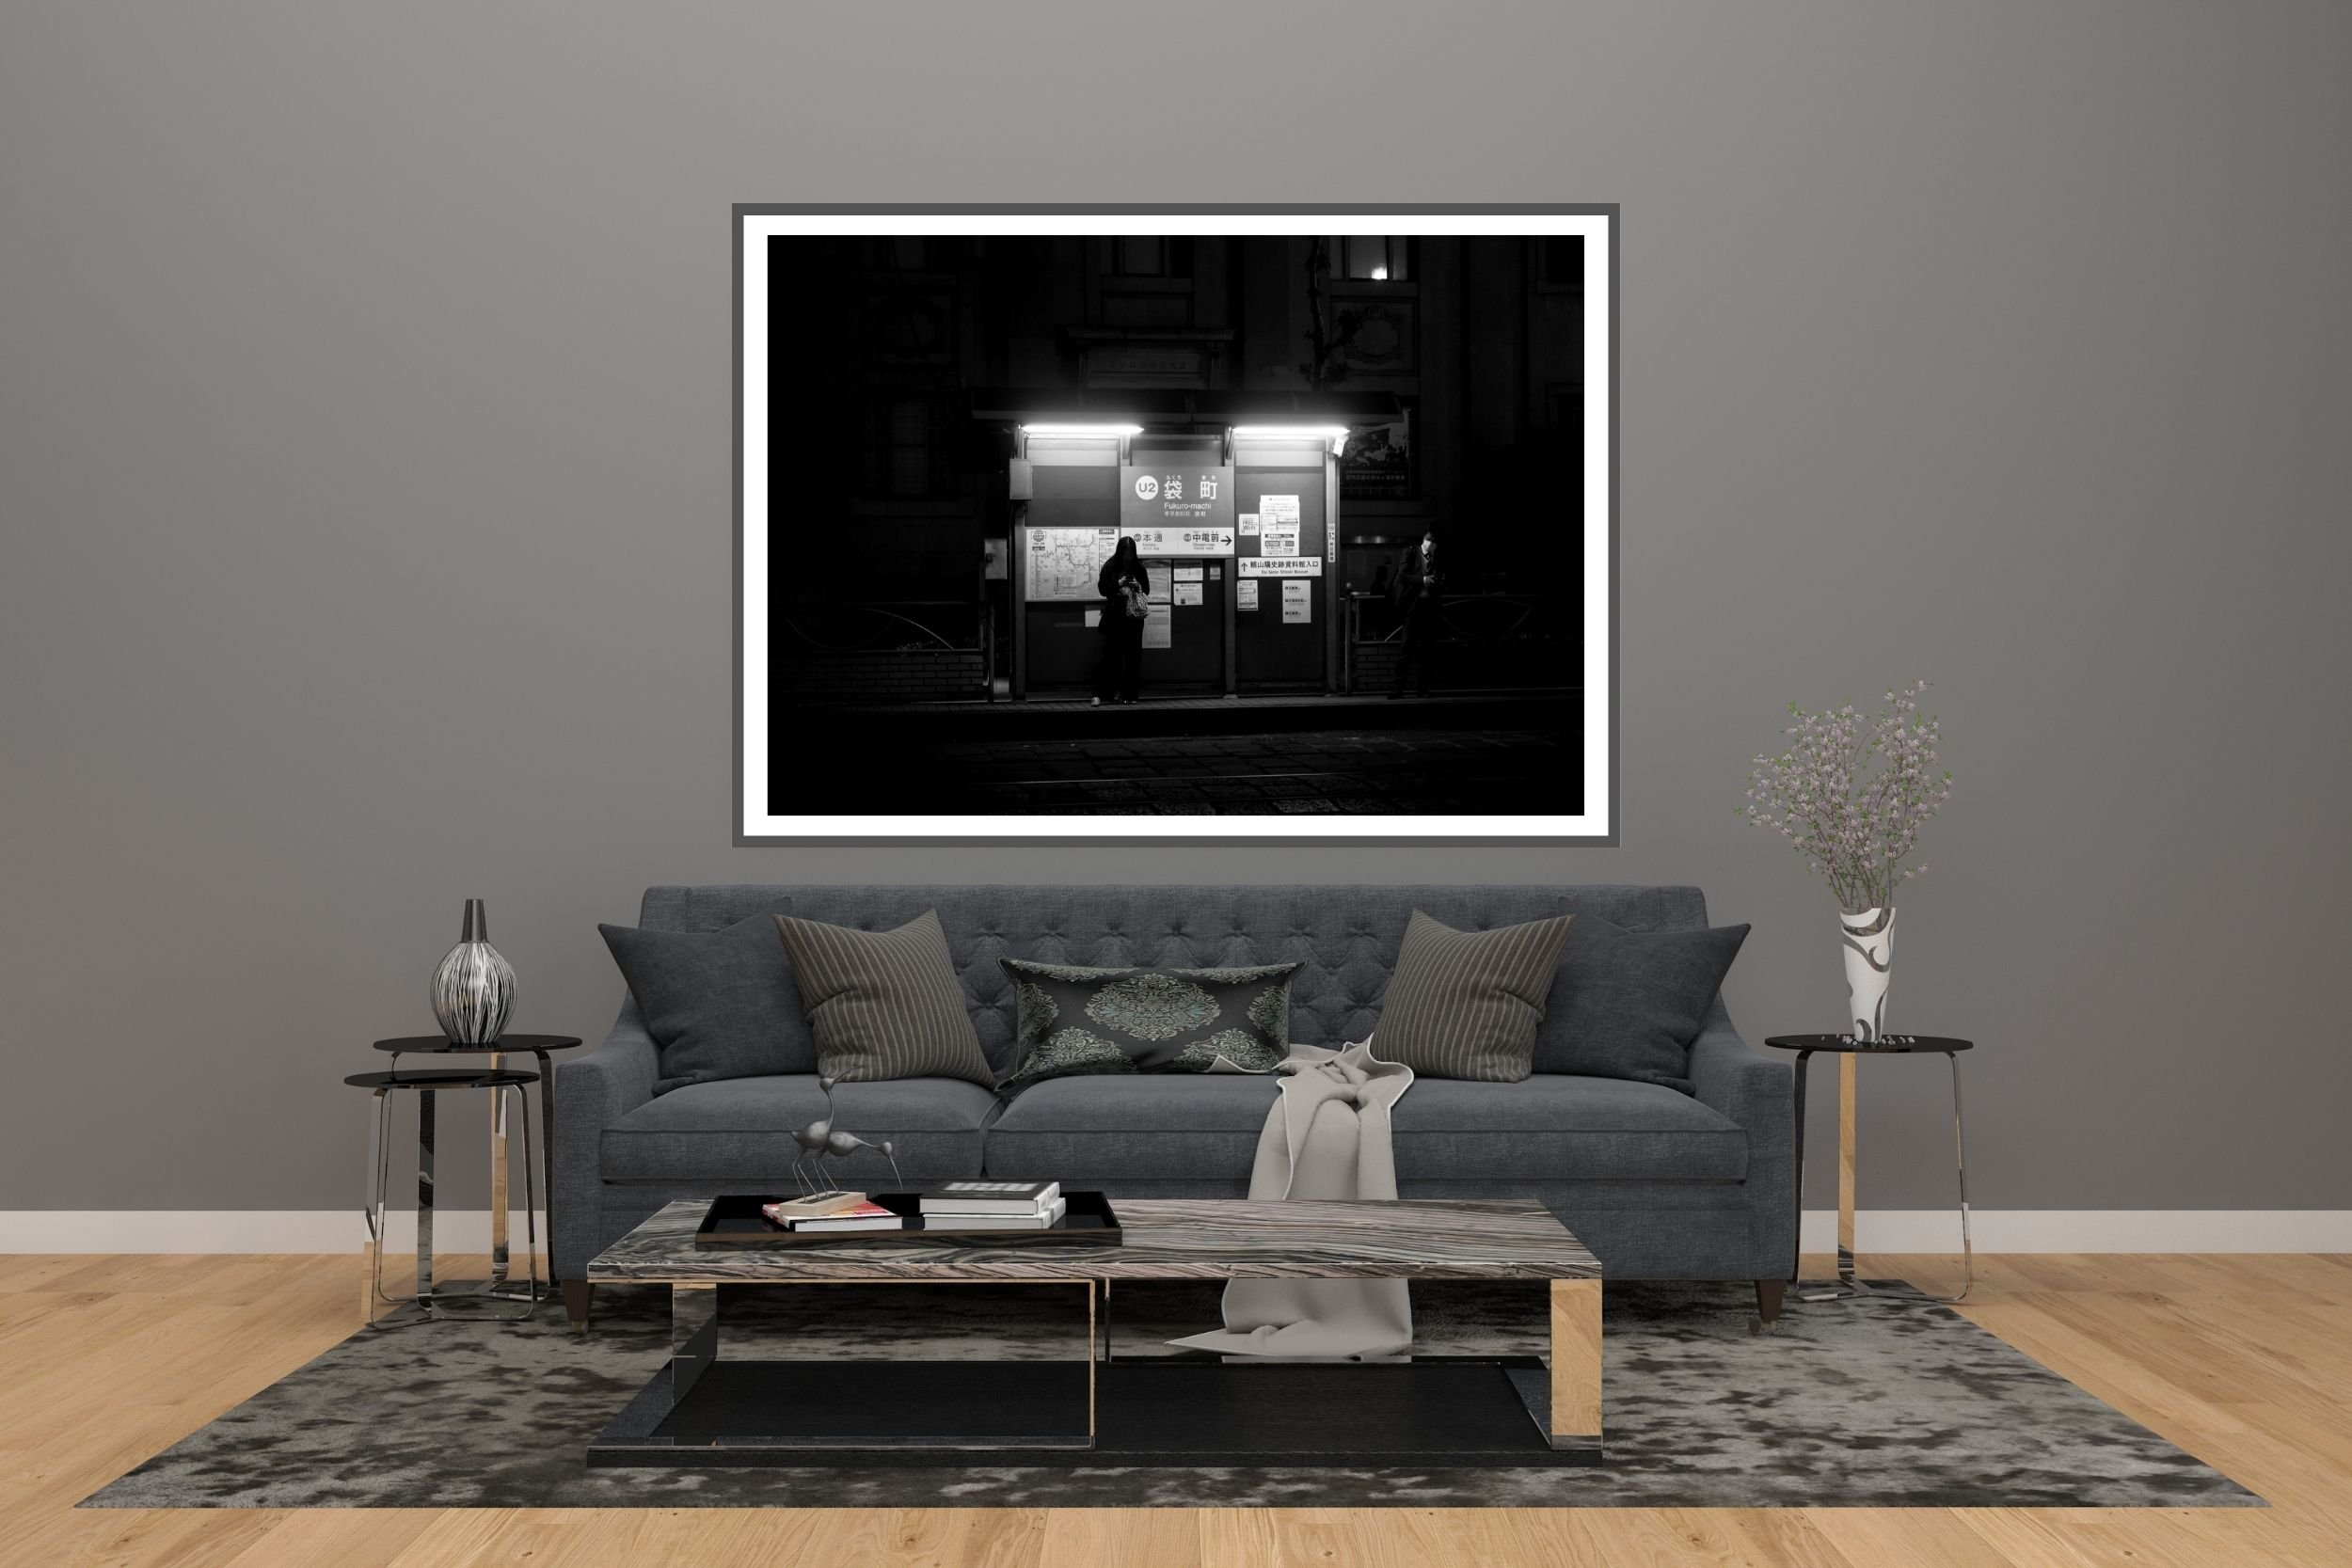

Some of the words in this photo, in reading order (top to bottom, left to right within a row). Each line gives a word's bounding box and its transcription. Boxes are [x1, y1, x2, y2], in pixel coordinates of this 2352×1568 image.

[1138, 483, 1156, 493] U2
[1164, 501, 1212, 510] Fukuro-machi
[1192, 533, 1219, 543] 中電前
